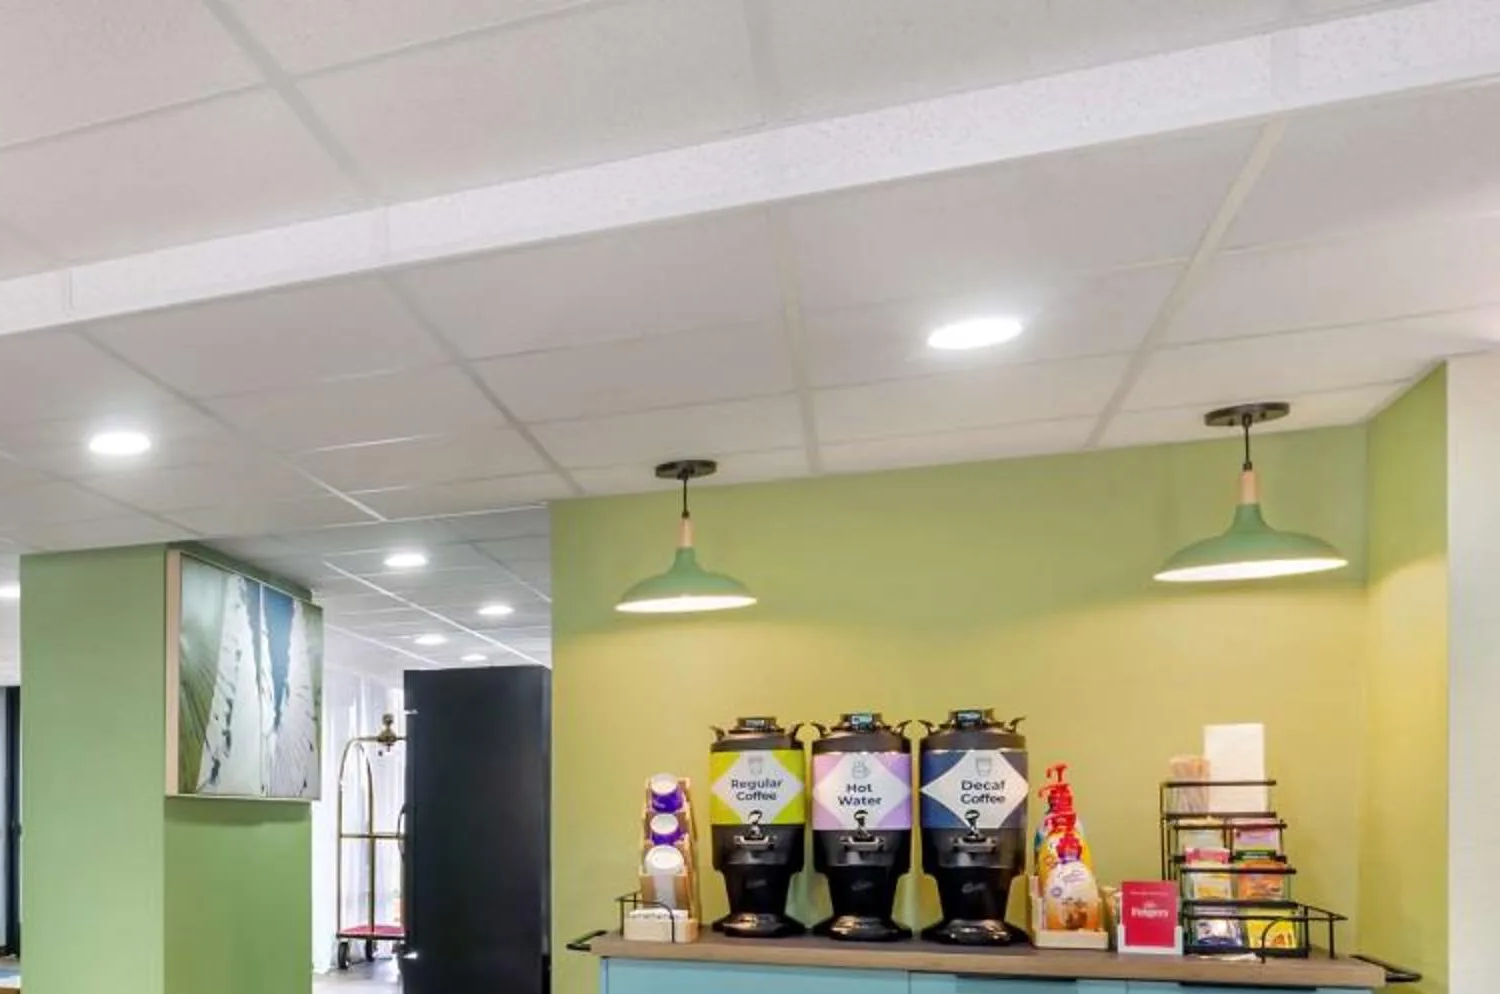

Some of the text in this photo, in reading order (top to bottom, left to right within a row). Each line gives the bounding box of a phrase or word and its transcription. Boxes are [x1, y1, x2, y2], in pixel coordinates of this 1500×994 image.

[731, 777, 783, 791] Regular
[846, 783, 872, 793] Hot
[961, 779, 1005, 790] Decaf
[736, 791, 777, 801] Coffee
[837, 796, 882, 806] Water
[960, 793, 1006, 804] Coffee
